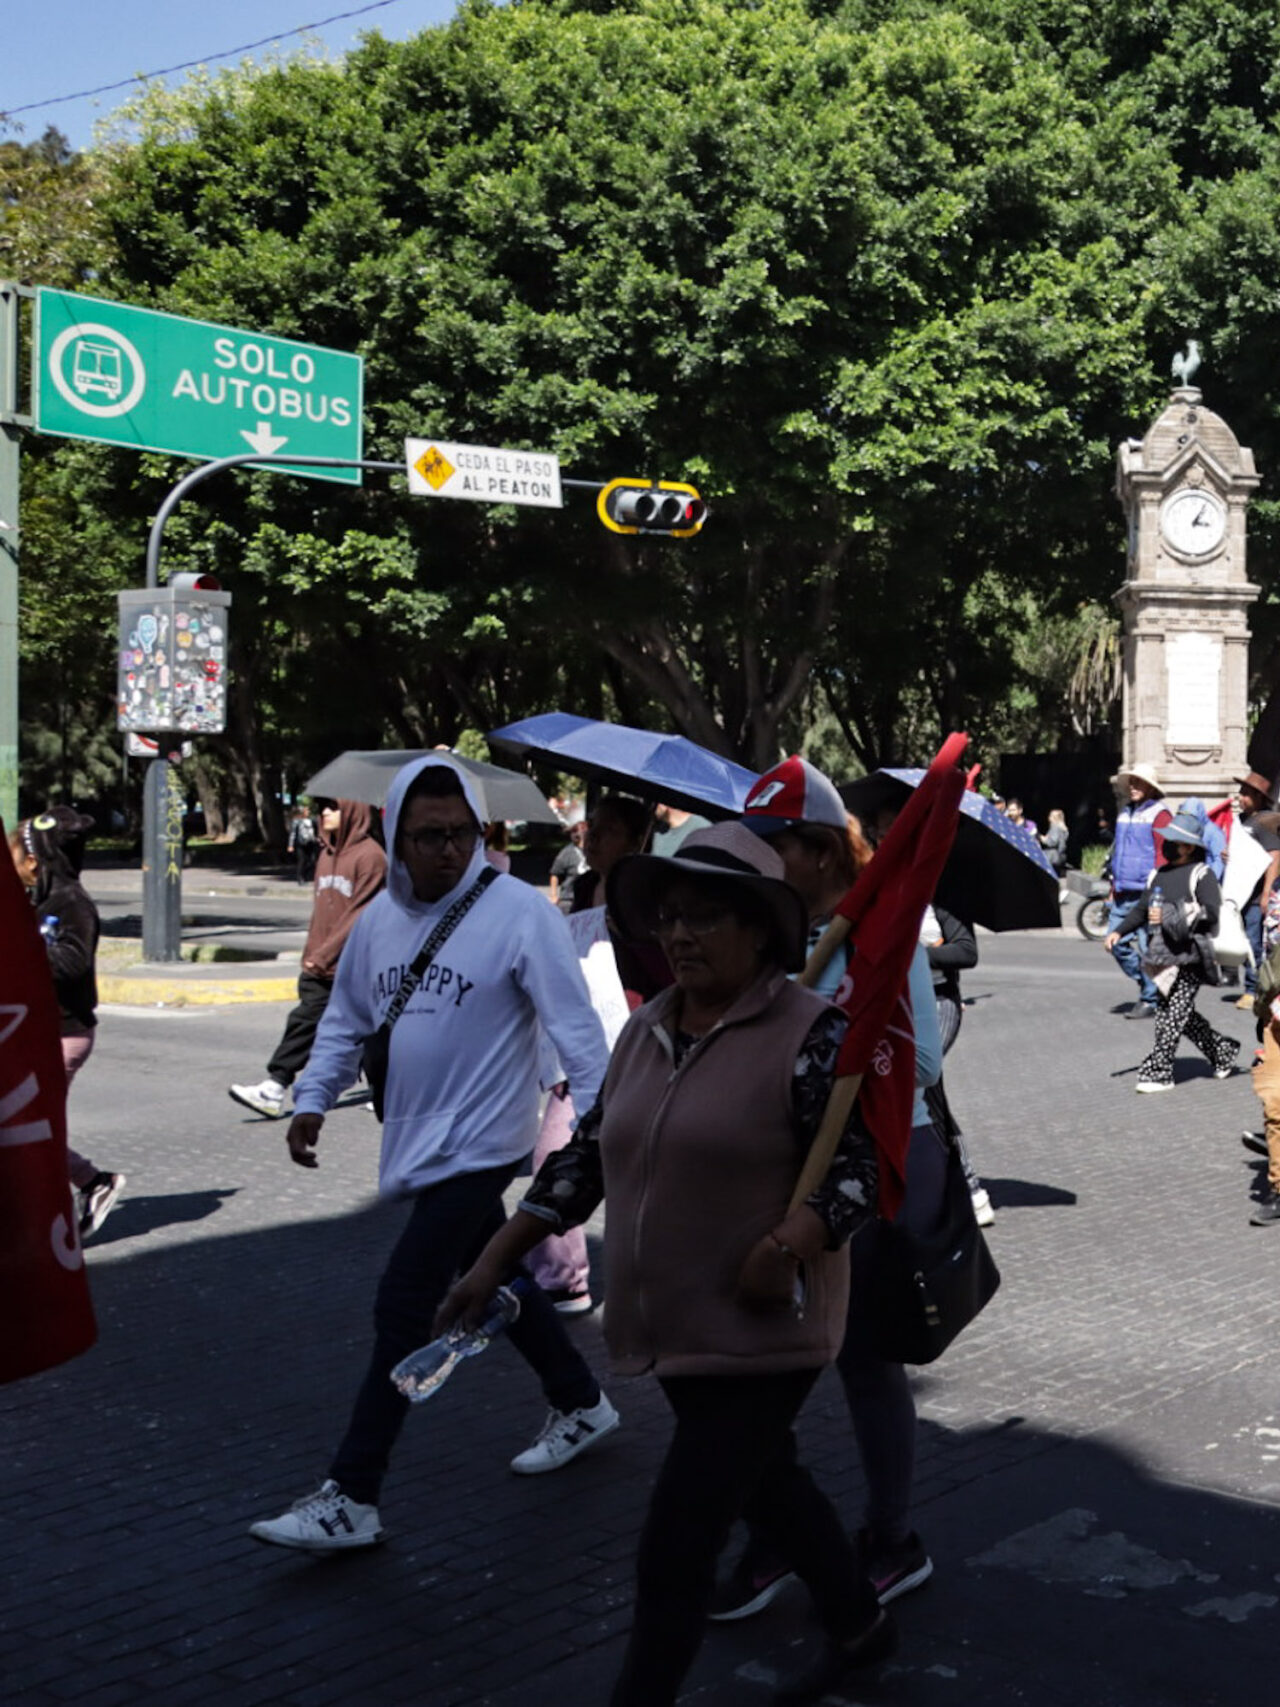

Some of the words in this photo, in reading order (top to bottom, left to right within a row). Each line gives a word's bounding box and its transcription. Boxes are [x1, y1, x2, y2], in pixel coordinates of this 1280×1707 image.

[213, 338, 315, 384] SOLO
[171, 369, 352, 427] AUTOBUS
[456, 452, 490, 470] CEDA
[496, 458, 511, 473] EL
[516, 460, 552, 478] PASO
[463, 475, 482, 491] AL
[488, 477, 552, 498] PEATON
[372, 963, 474, 1007] ADAPPY
